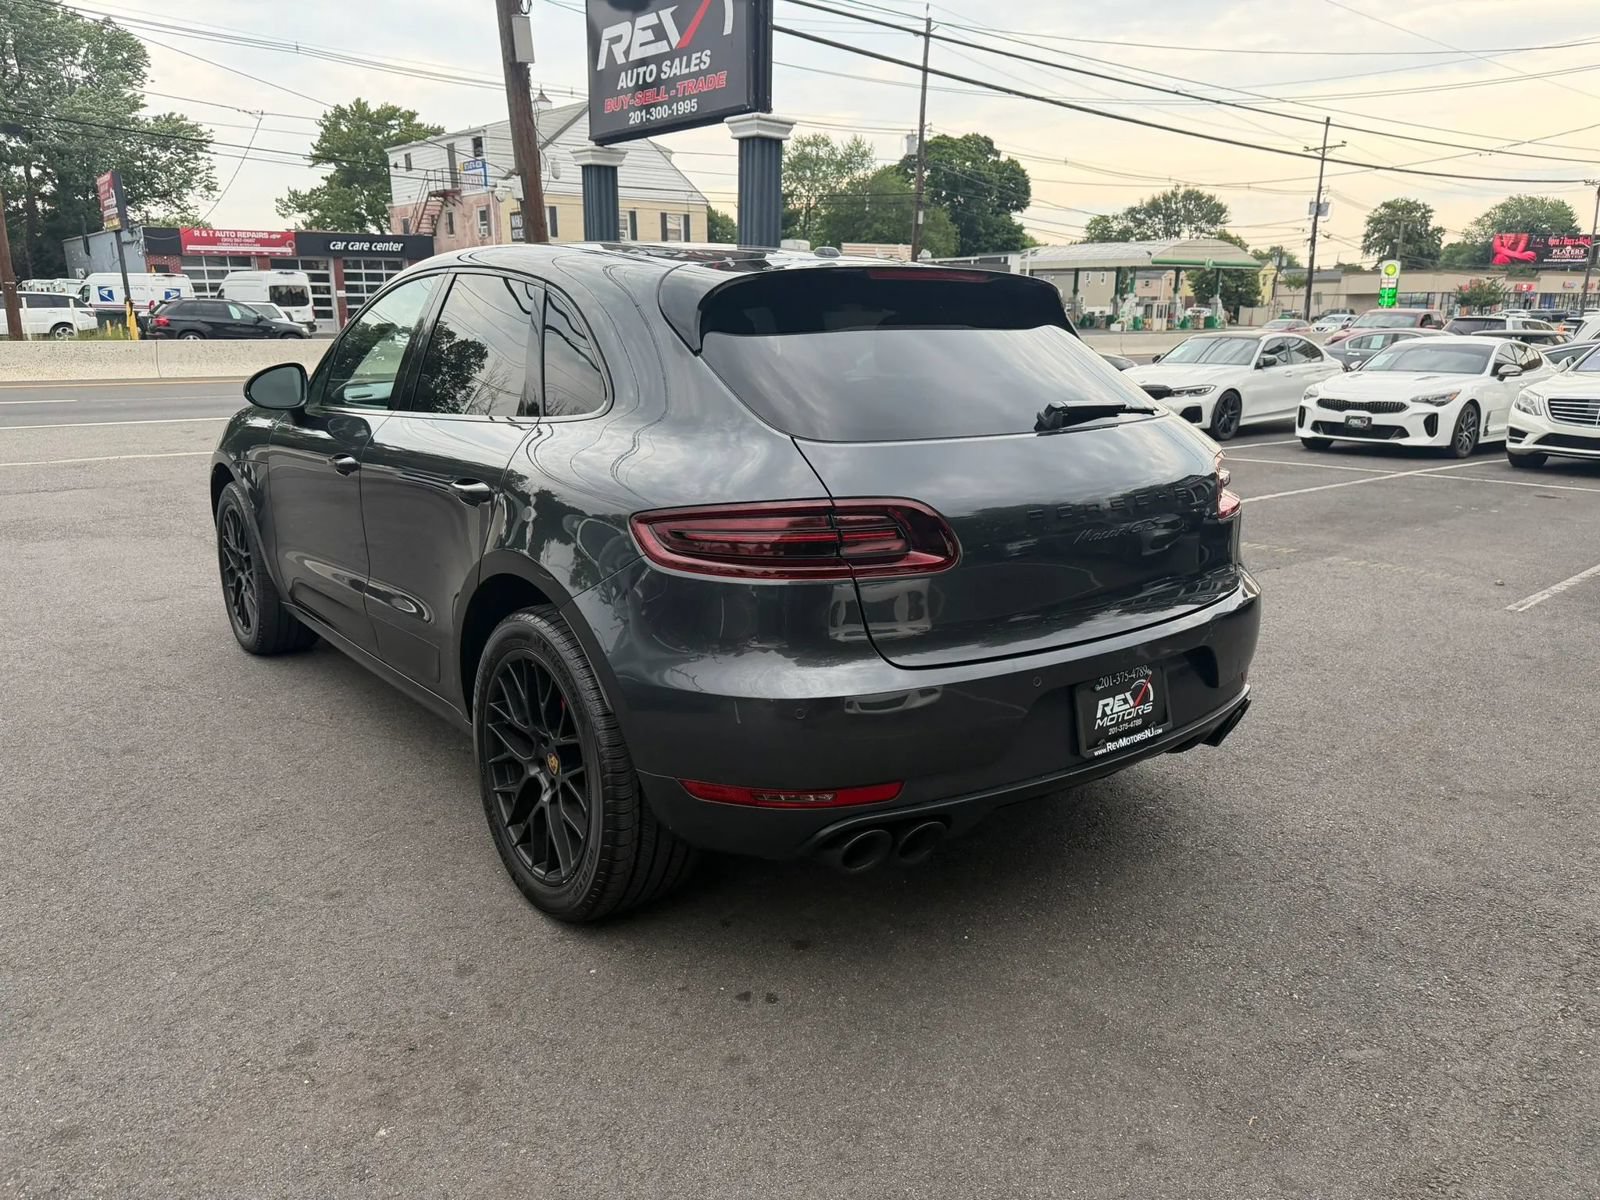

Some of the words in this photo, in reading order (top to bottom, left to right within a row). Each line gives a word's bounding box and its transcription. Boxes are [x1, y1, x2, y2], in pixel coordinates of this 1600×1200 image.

[616, 63, 657, 91] AUTO
[660, 49, 712, 80] SALES
[628, 98, 698, 125] 201-300-1995
[330, 240, 347, 250] car
[348, 241, 370, 251] care
[371, 241, 403, 251] center
[1552, 247, 1584, 255] PLAYERS
[1099, 665, 1148, 688] 201-375-4789
[1094, 702, 1153, 731] MOTORS
